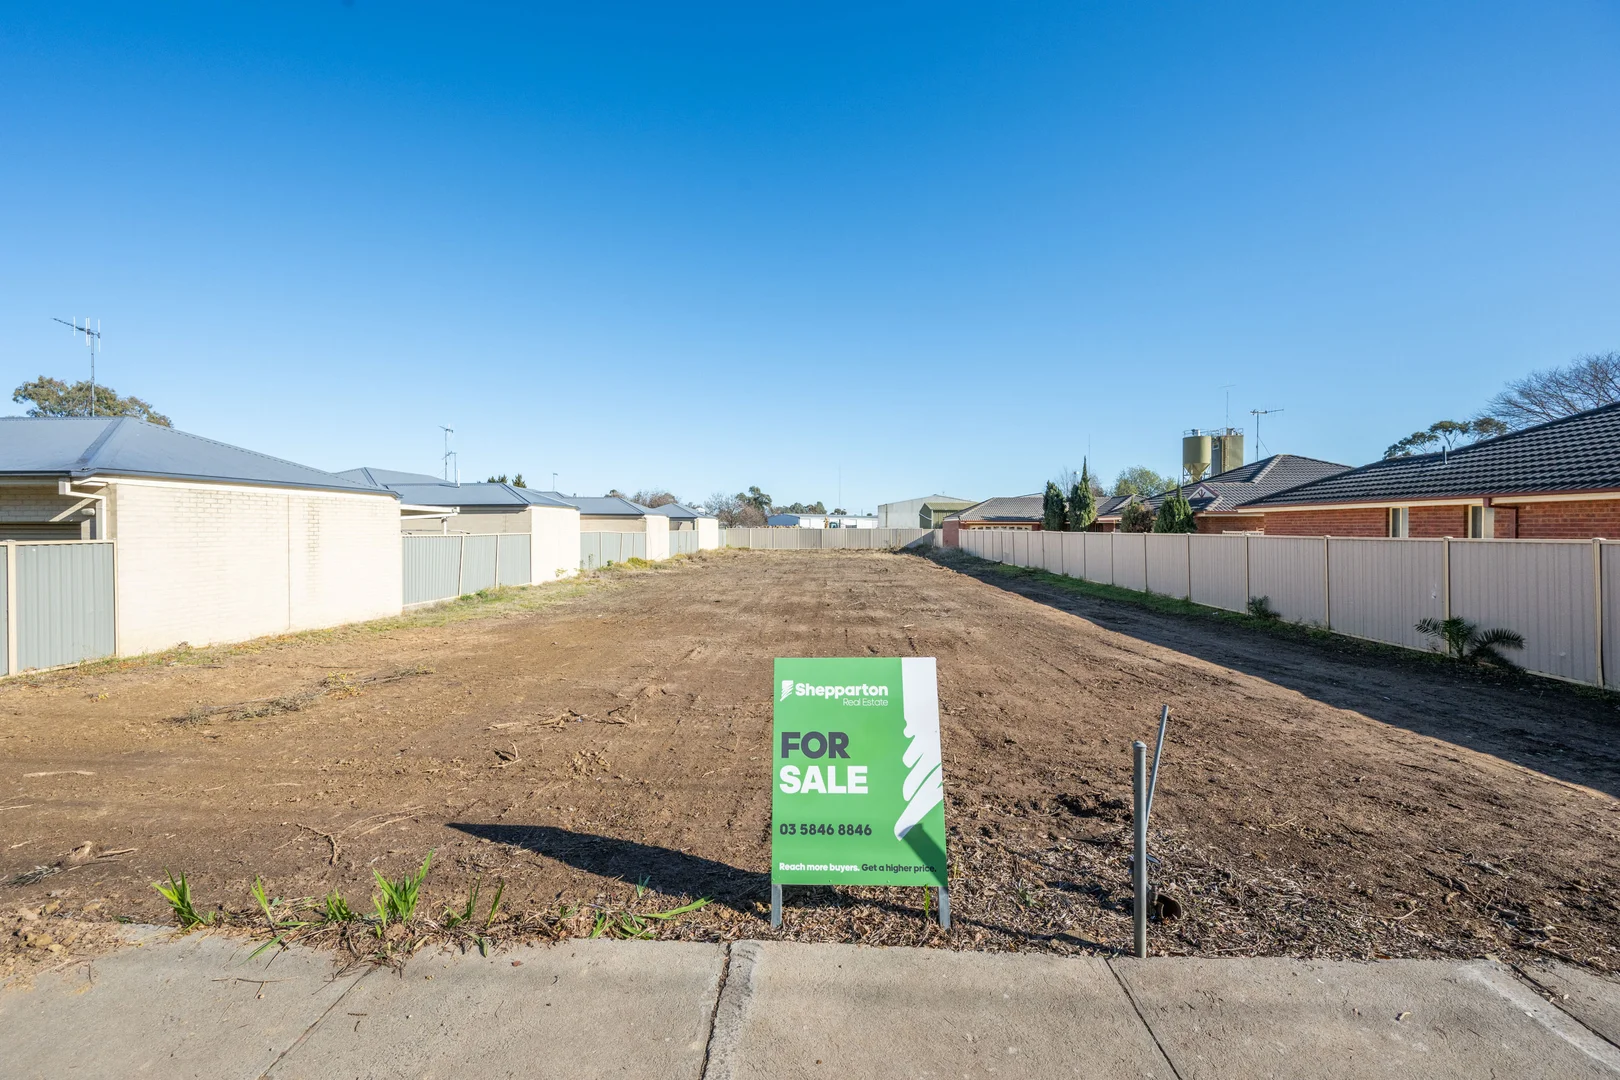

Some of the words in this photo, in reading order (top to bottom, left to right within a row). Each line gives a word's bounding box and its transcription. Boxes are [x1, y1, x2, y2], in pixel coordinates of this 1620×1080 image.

[795, 683, 888, 699] Shepparton
[843, 698, 860, 706] Real
[862, 698, 888, 706] Estate
[781, 731, 850, 759] FOR
[779, 765, 868, 794] SALE
[780, 823, 796, 835] 03
[800, 824, 834, 835] 5846
[838, 824, 872, 836] 8846
[779, 863, 806, 871] Reach
[829, 863, 860, 873] buyers.
[861, 863, 877, 872] Get
[885, 864, 912, 873] higher
[913, 864, 937, 873] price.
